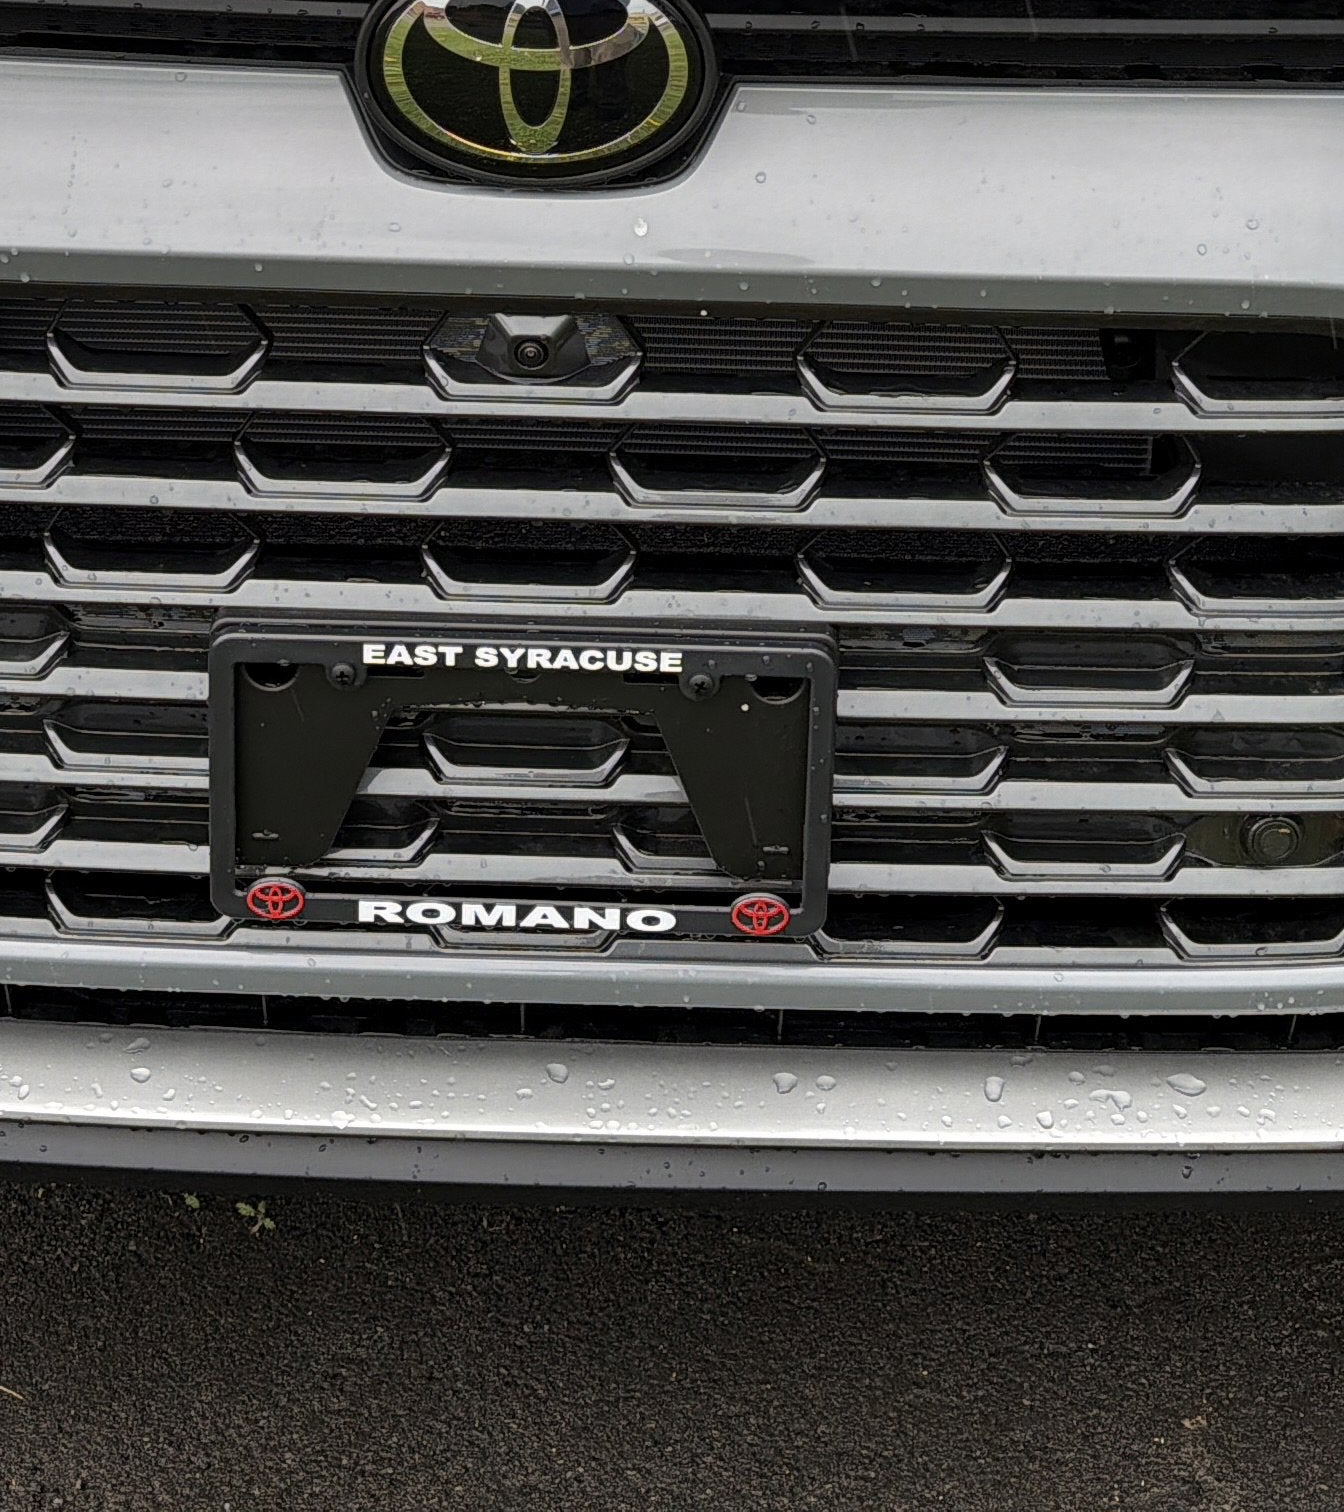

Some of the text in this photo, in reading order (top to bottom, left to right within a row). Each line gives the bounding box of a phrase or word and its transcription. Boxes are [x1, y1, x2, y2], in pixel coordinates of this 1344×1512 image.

[362, 643, 684, 674] EAST SYRACUSE
[357, 899, 677, 933] ROMANO
